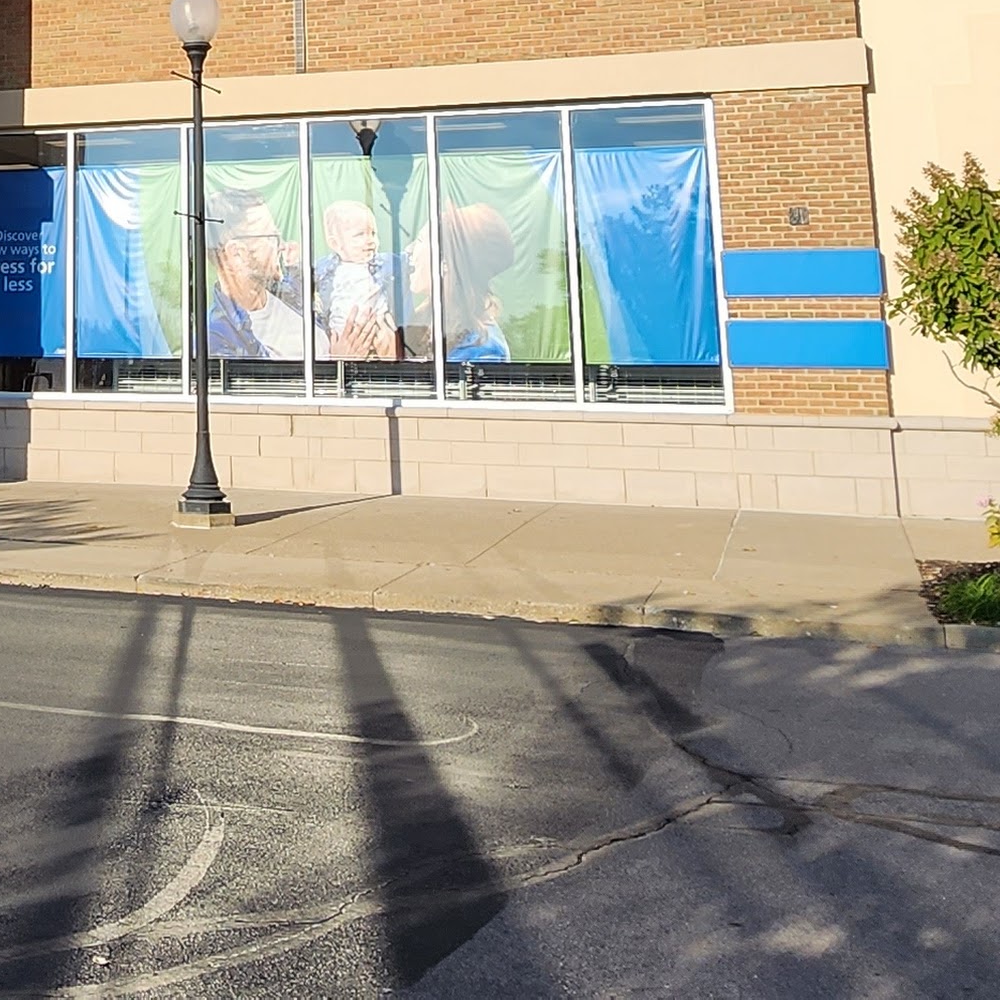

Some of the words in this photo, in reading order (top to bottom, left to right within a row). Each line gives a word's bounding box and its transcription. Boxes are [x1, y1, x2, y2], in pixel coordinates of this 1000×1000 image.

[10, 245, 40, 258] ways
[42, 243, 57, 255] to
[29, 257, 56, 275] for
[3, 275, 34, 292] less
